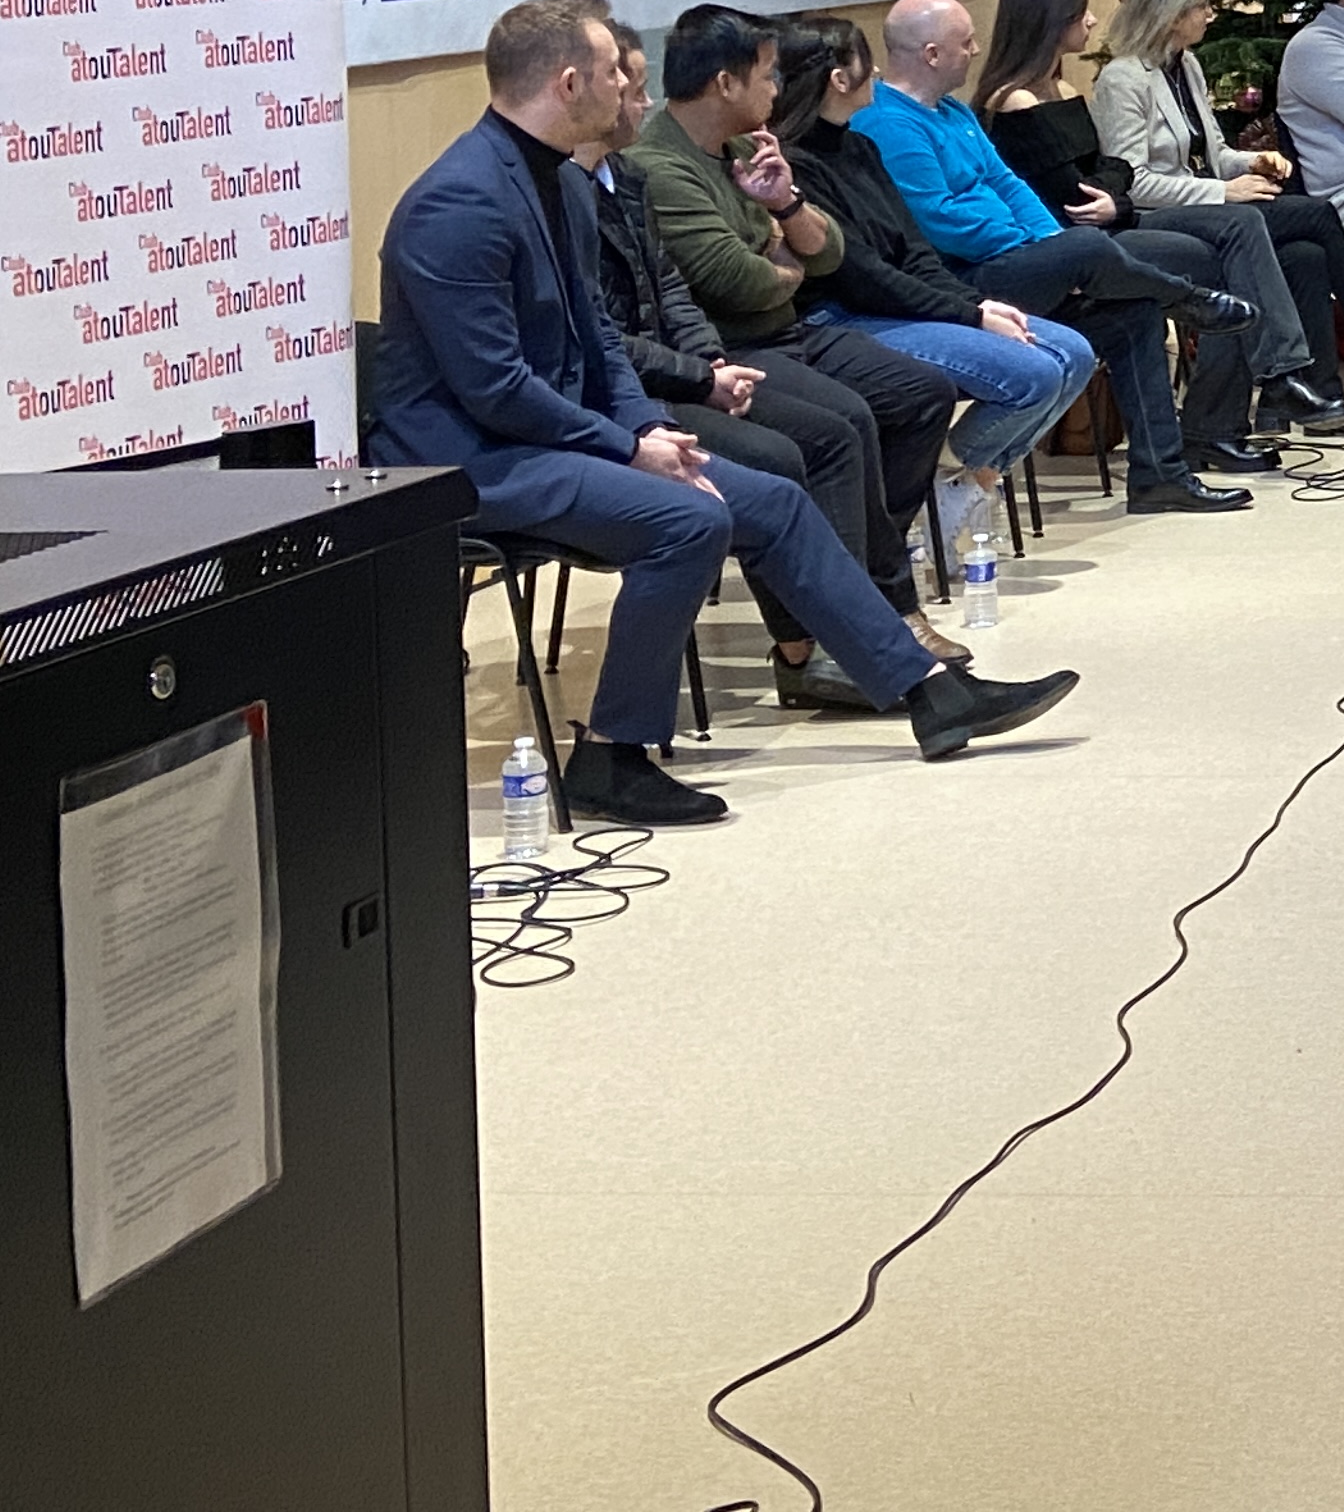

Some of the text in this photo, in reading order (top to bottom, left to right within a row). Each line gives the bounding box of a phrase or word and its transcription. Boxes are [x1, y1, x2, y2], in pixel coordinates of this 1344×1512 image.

[71, 42, 167, 83] atouTalent
[204, 31, 295, 69] atouTalent
[7, 121, 103, 163] atouTalent
[142, 105, 232, 147] atouTalent
[77, 178, 173, 222] atouTalent
[210, 161, 301, 202] atouTalent
[13, 250, 109, 297] atouTalent
[148, 229, 237, 274] atouTalent
[216, 273, 306, 318] atouTalent
[82, 297, 179, 344] atouTalent
[153, 343, 243, 391] atouTalent
[18, 370, 115, 421] atouTalent
